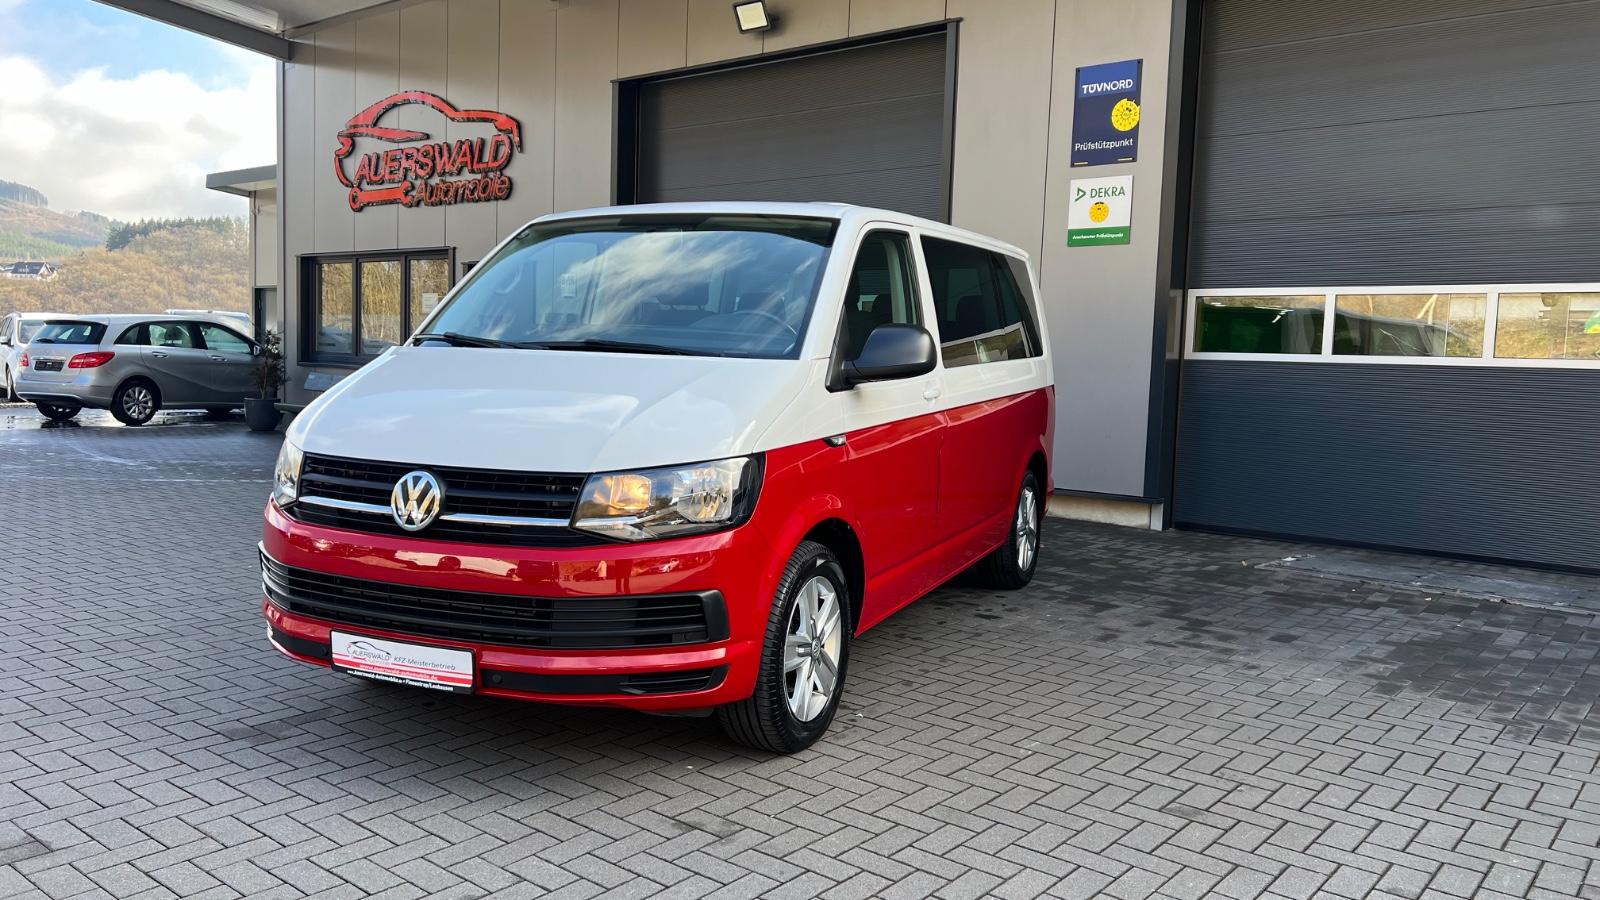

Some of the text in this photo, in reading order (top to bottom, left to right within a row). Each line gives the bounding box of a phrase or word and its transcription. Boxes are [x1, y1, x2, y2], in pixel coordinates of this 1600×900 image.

[1074, 138, 1133, 151] Prüfstützpunkt
[353, 133, 512, 186] AUERSWALD
[413, 174, 512, 207] Automobile
[1090, 186, 1126, 198] DEKRA
[394, 656, 456, 671] KFZ-Meisterbetrieb
